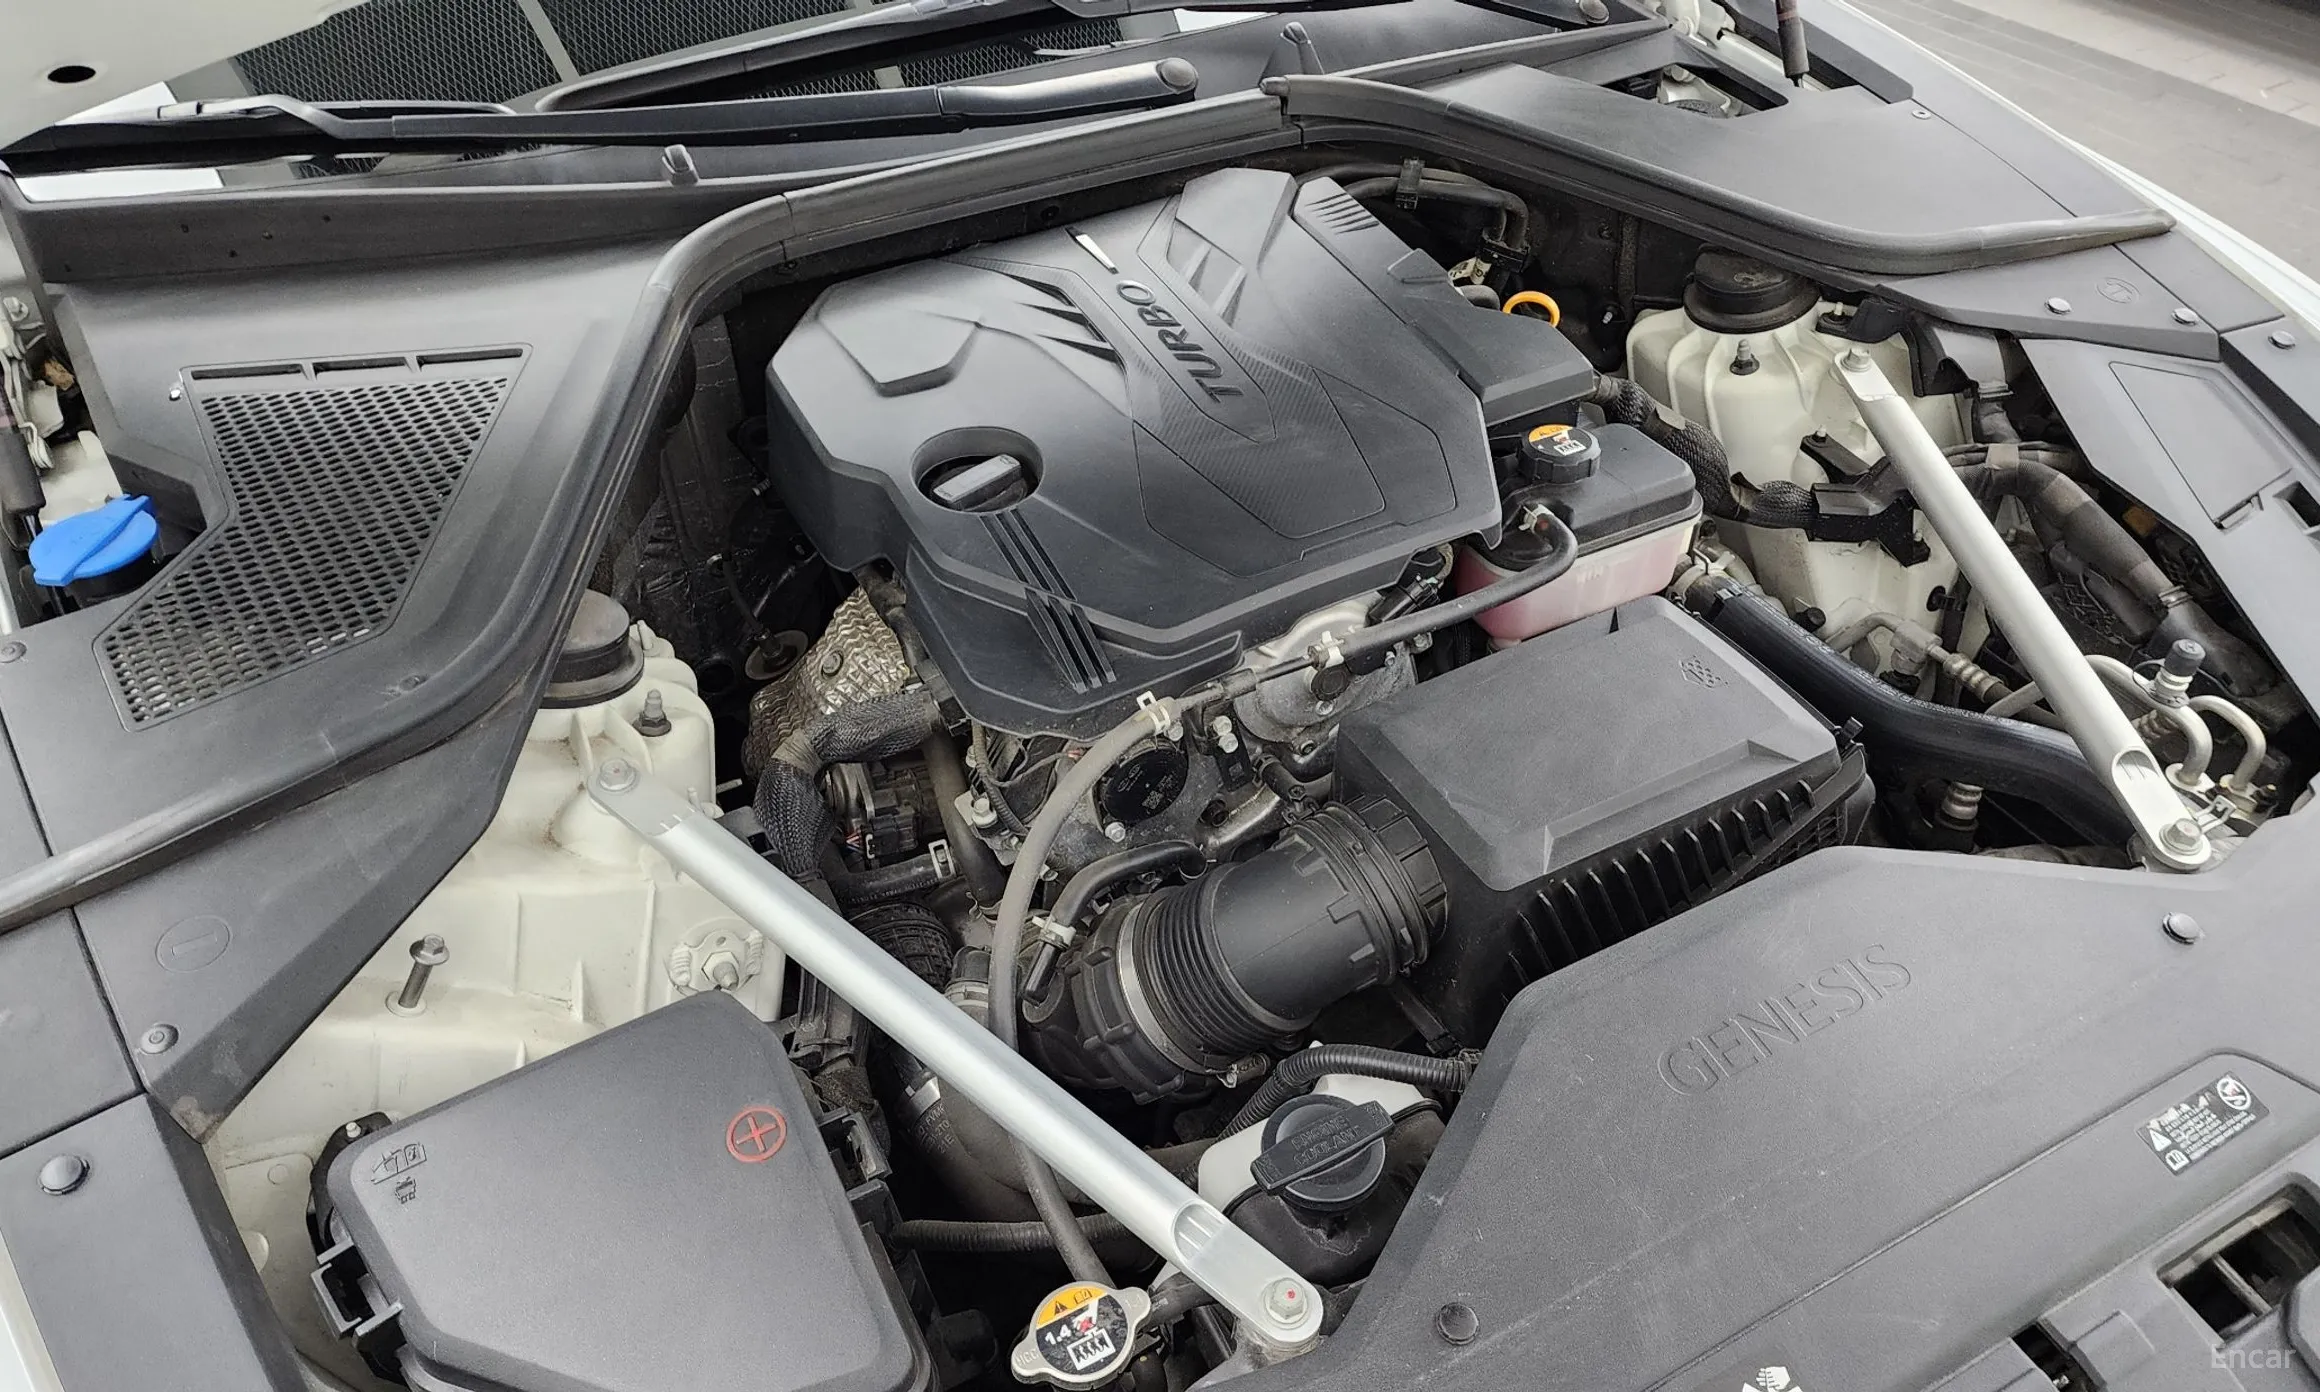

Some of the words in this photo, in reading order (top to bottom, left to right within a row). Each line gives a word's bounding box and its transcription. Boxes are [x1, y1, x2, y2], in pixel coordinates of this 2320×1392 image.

[1116, 279, 1244, 404] TURBO
[1657, 943, 1912, 1097] GENESIS
[1044, 1324, 1072, 1345] 1.4
